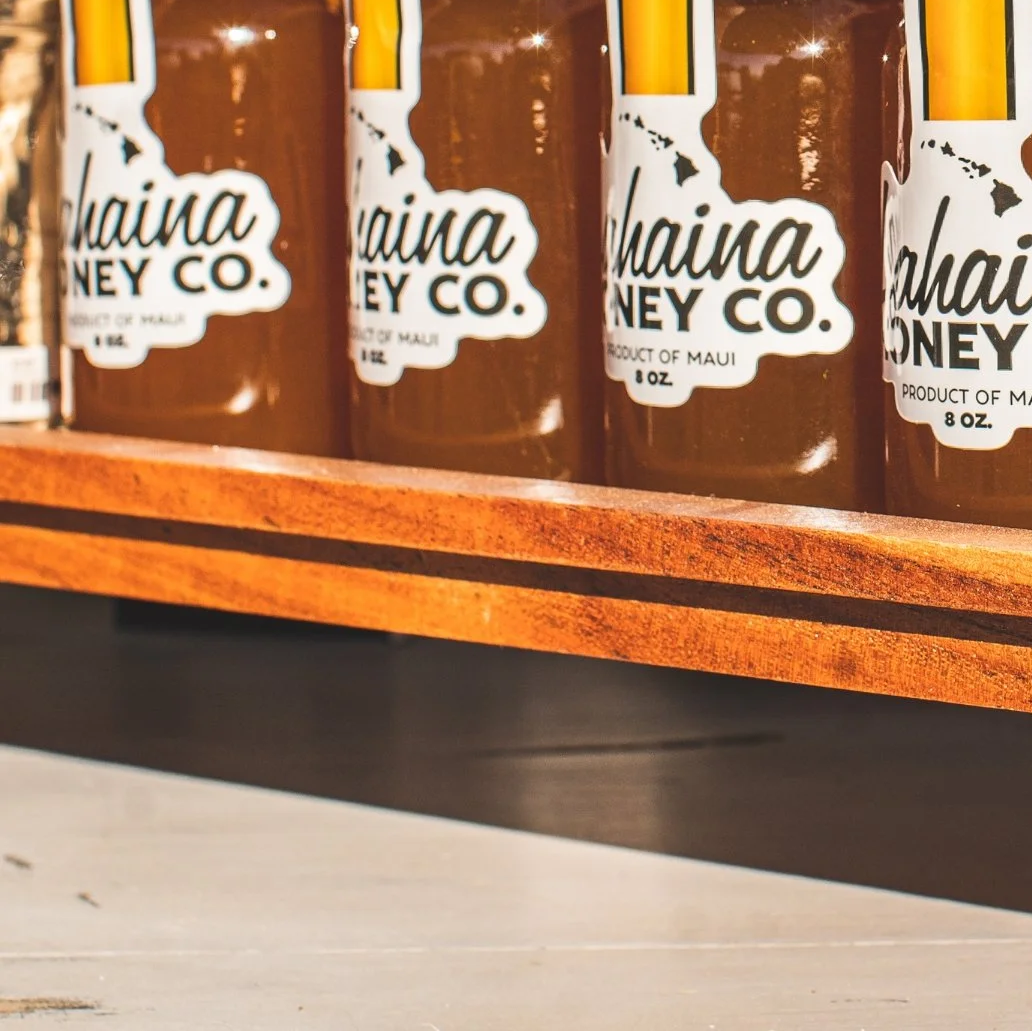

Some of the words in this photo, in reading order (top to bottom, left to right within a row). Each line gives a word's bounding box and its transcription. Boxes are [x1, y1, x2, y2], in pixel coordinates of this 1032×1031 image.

[609, 165, 822, 283] haina
[62, 256, 151, 297] NEY
[173, 253, 269, 294] CO.
[356, 269, 410, 313] EY
[428, 273, 526, 317] CO.
[609, 284, 703, 333] NEY
[724, 287, 833, 335] CO.
[659, 348, 681, 365] OF
[687, 350, 735, 367] MAUI
[885, 317, 1031, 372] ONEY
[635, 370, 643, 384] 8
[647, 371, 673, 387] OZ.
[902, 383, 969, 406] PRODUCT
[976, 389, 1002, 407] OF
[944, 411, 956, 428] 8
[960, 412, 993, 430] OZ.
